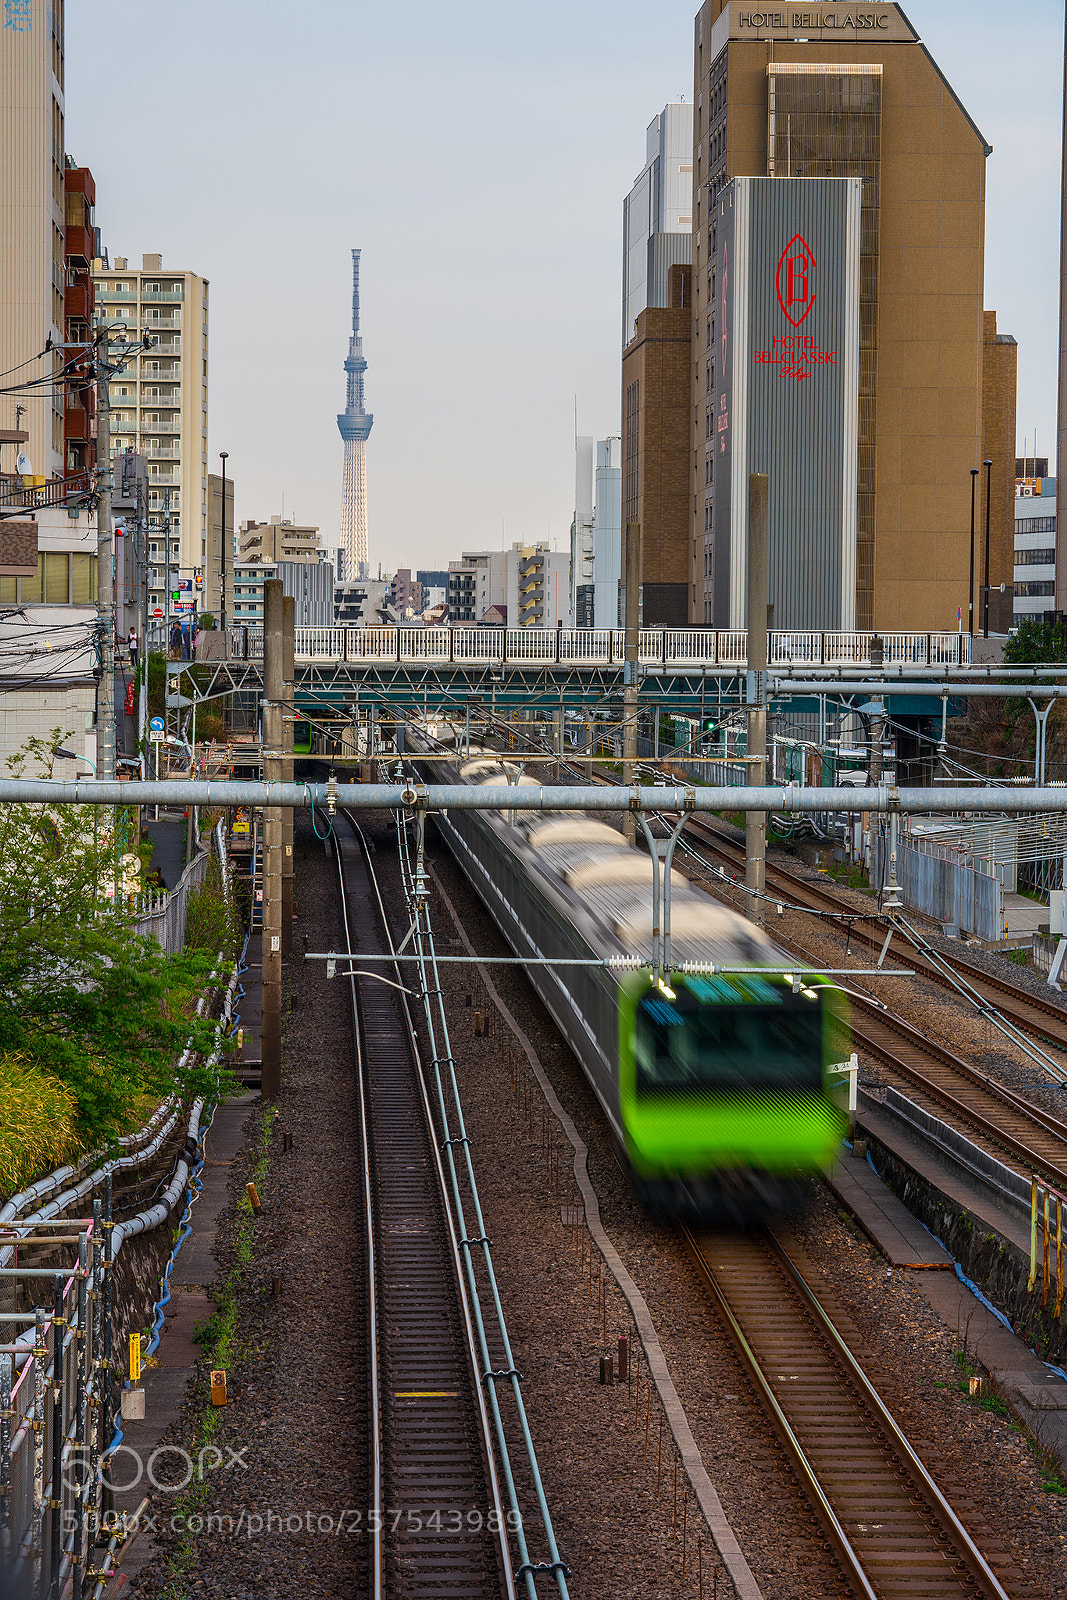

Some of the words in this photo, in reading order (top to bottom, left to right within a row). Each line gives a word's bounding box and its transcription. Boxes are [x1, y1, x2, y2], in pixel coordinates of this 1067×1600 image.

[739, 12, 788, 28] HOTEL
[792, 13, 888, 29] BELLCLASSIC
[772, 335, 819, 349] HOTEL
[754, 350, 838, 364] BELLCLASSIC
[778, 366, 813, 382] Tokyo
[214, 1373, 223, 1386] 8
